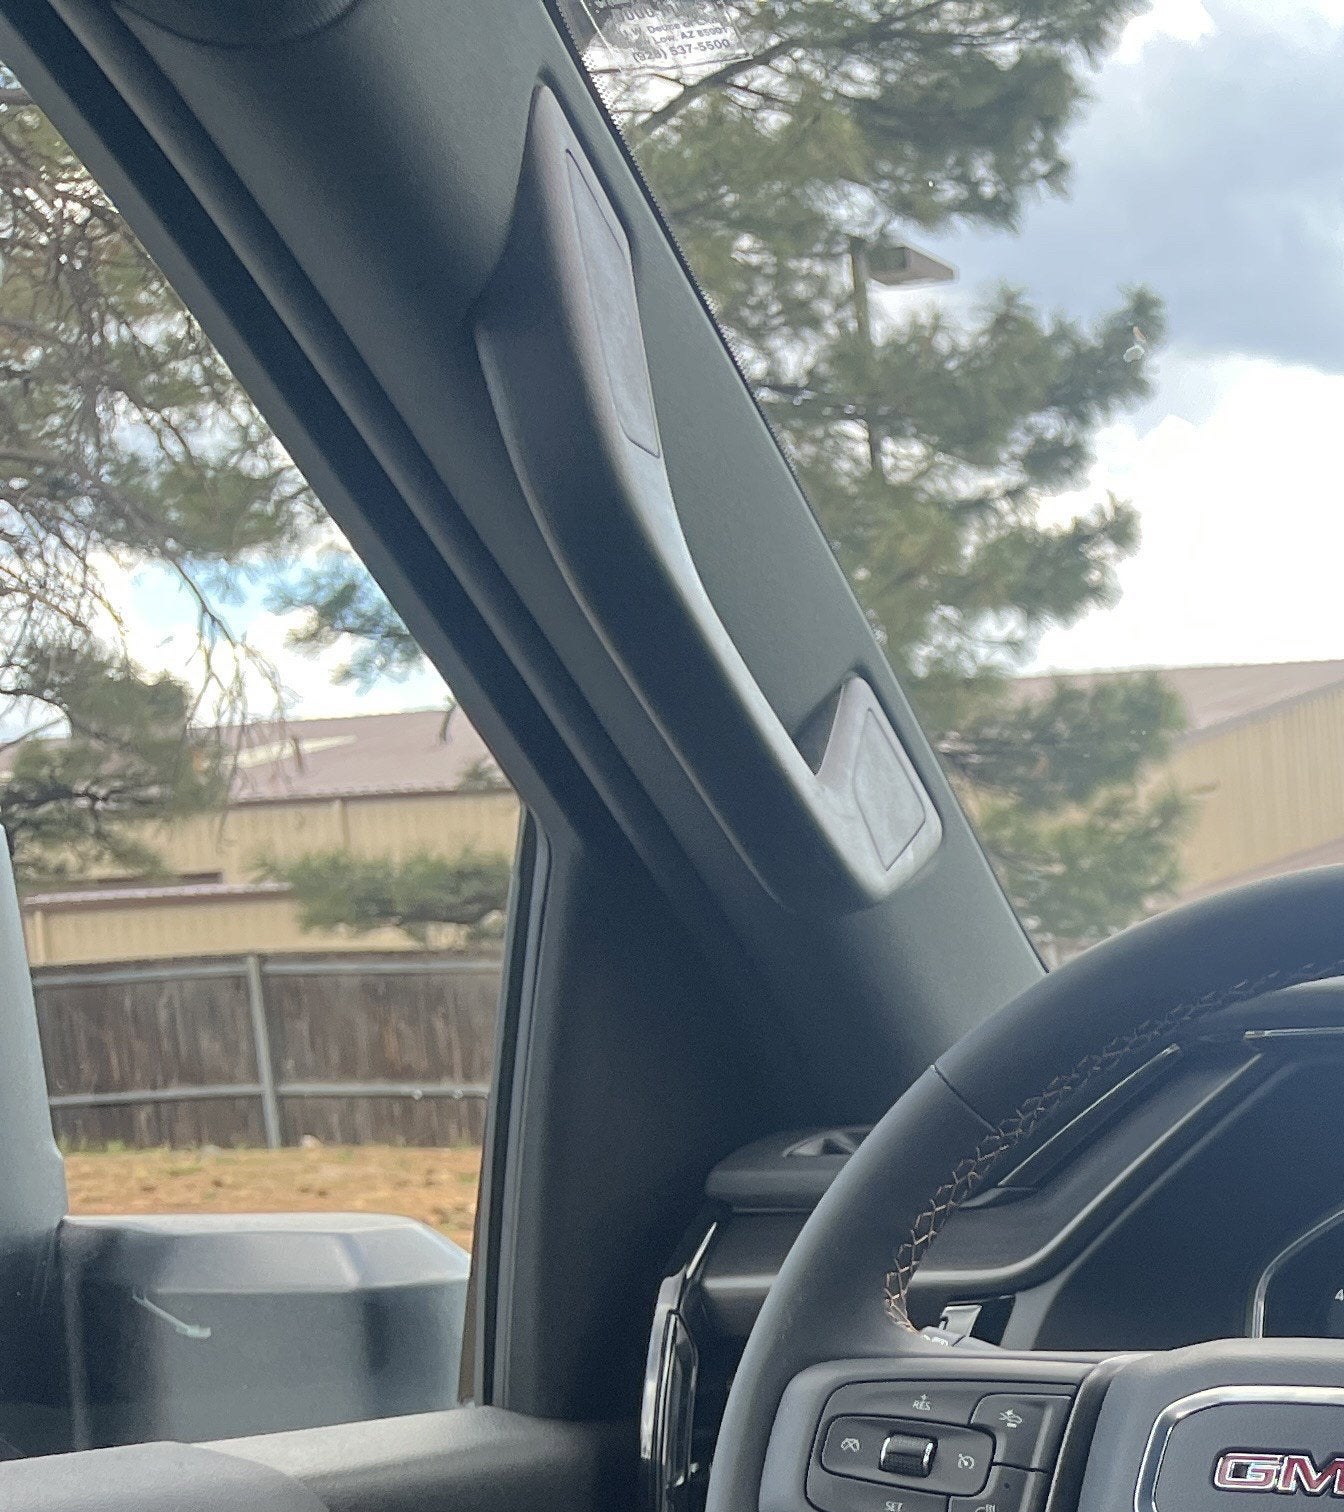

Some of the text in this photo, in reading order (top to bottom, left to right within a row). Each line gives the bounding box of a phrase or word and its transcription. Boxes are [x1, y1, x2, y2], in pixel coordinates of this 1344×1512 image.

[681, 29, 695, 39] AZ
[670, 38, 731, 56] 537-5500
[912, 1400, 931, 1411] RES
[885, 1501, 903, 1512] SET
